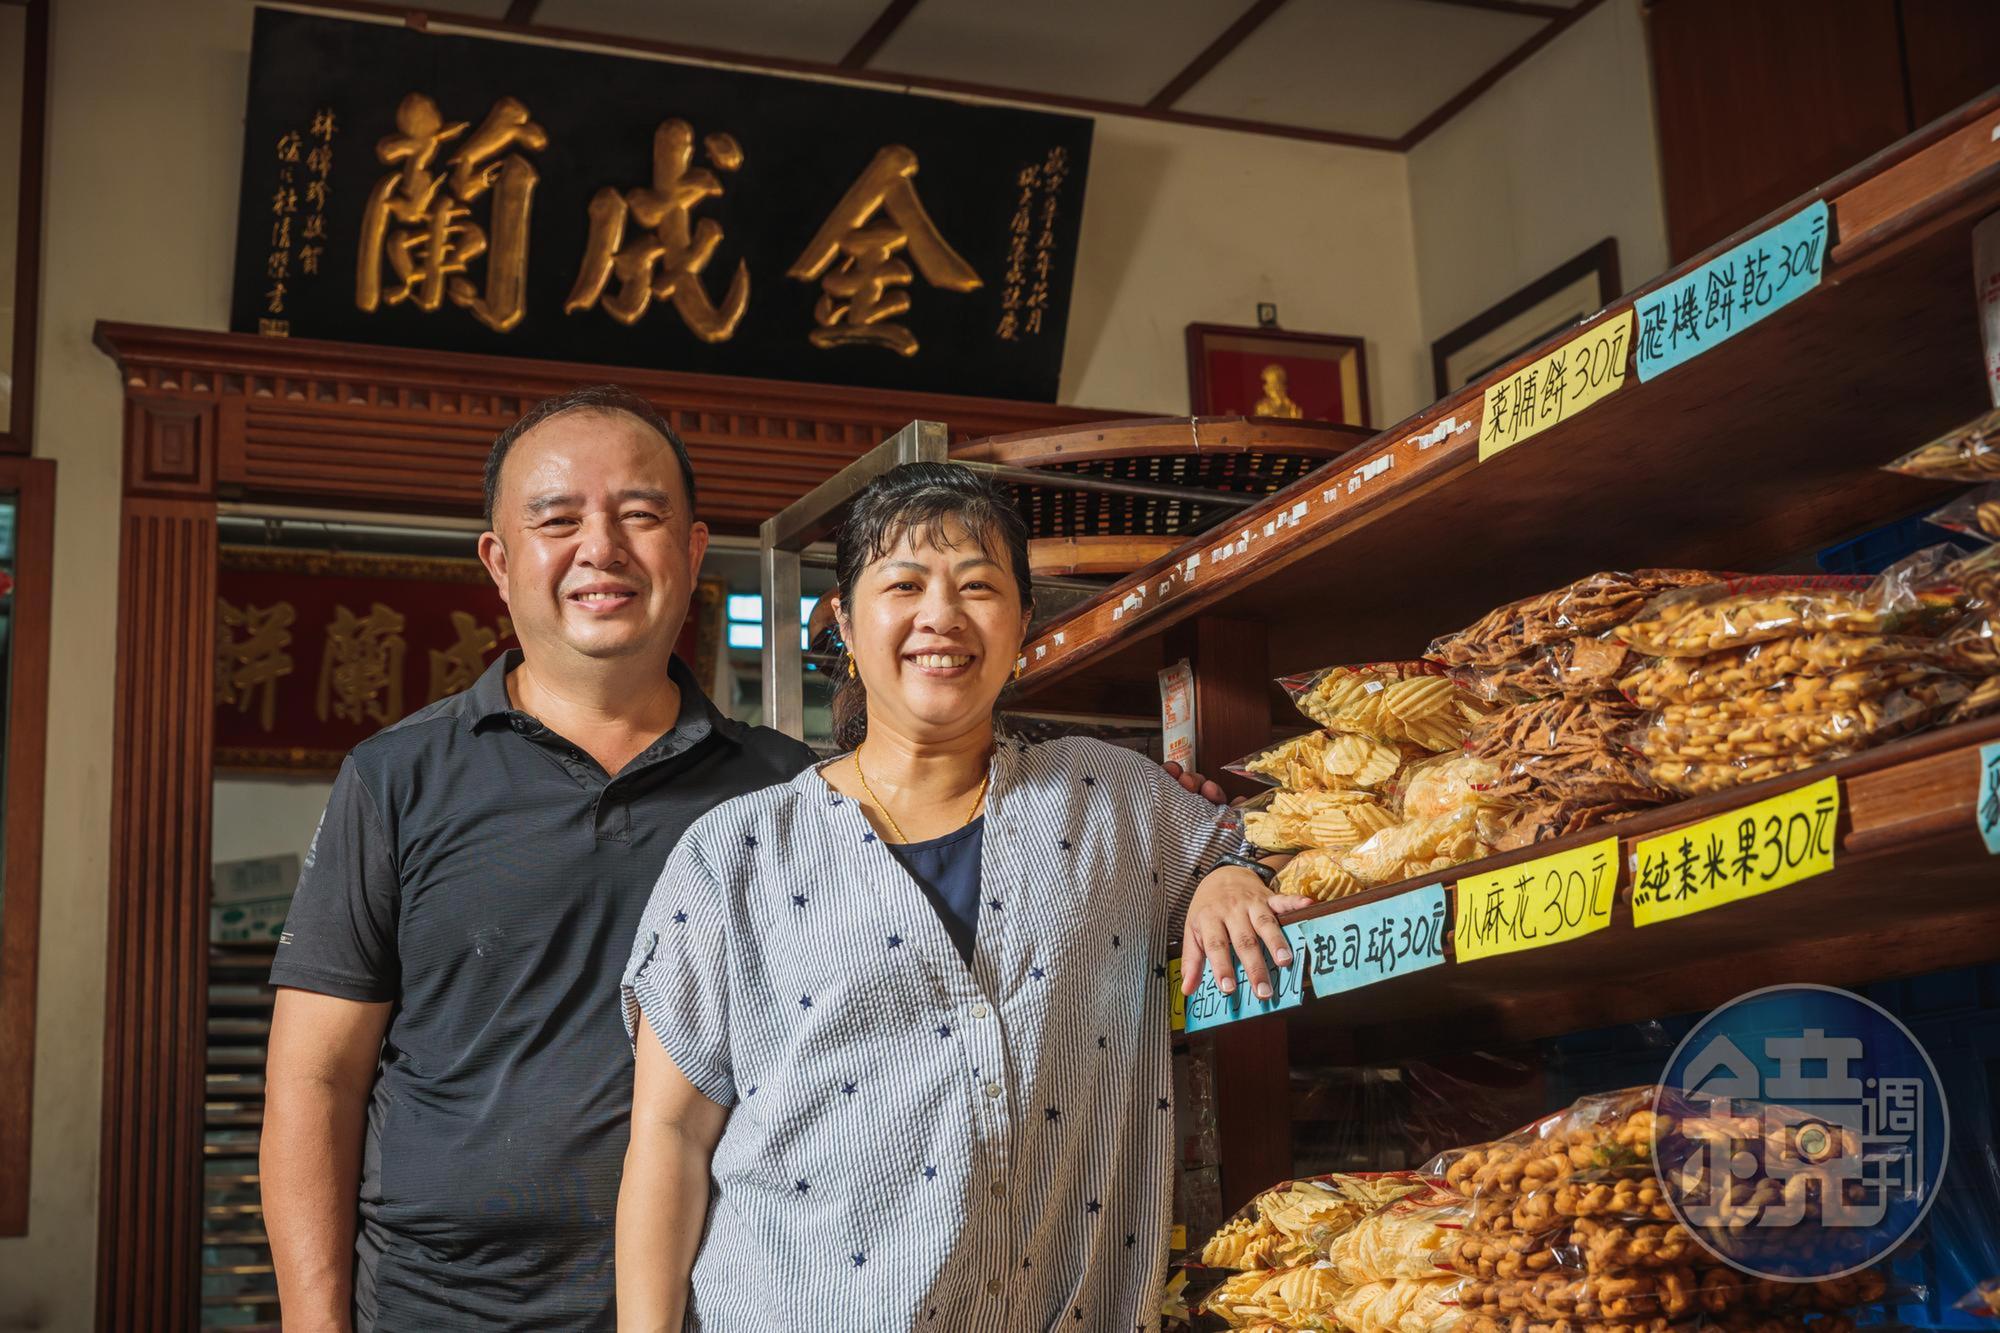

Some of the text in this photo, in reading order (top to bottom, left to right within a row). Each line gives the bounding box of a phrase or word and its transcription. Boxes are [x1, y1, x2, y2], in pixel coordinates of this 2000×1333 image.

[1637, 216, 1826, 362] 飛機餅乾30元
[1484, 325, 1627, 443] 菜脯餅30元
[1457, 853, 1607, 949] 小麻花30元
[1634, 796, 1835, 907] 純素米果30元
[1313, 900, 1445, 976] 起司球30元
